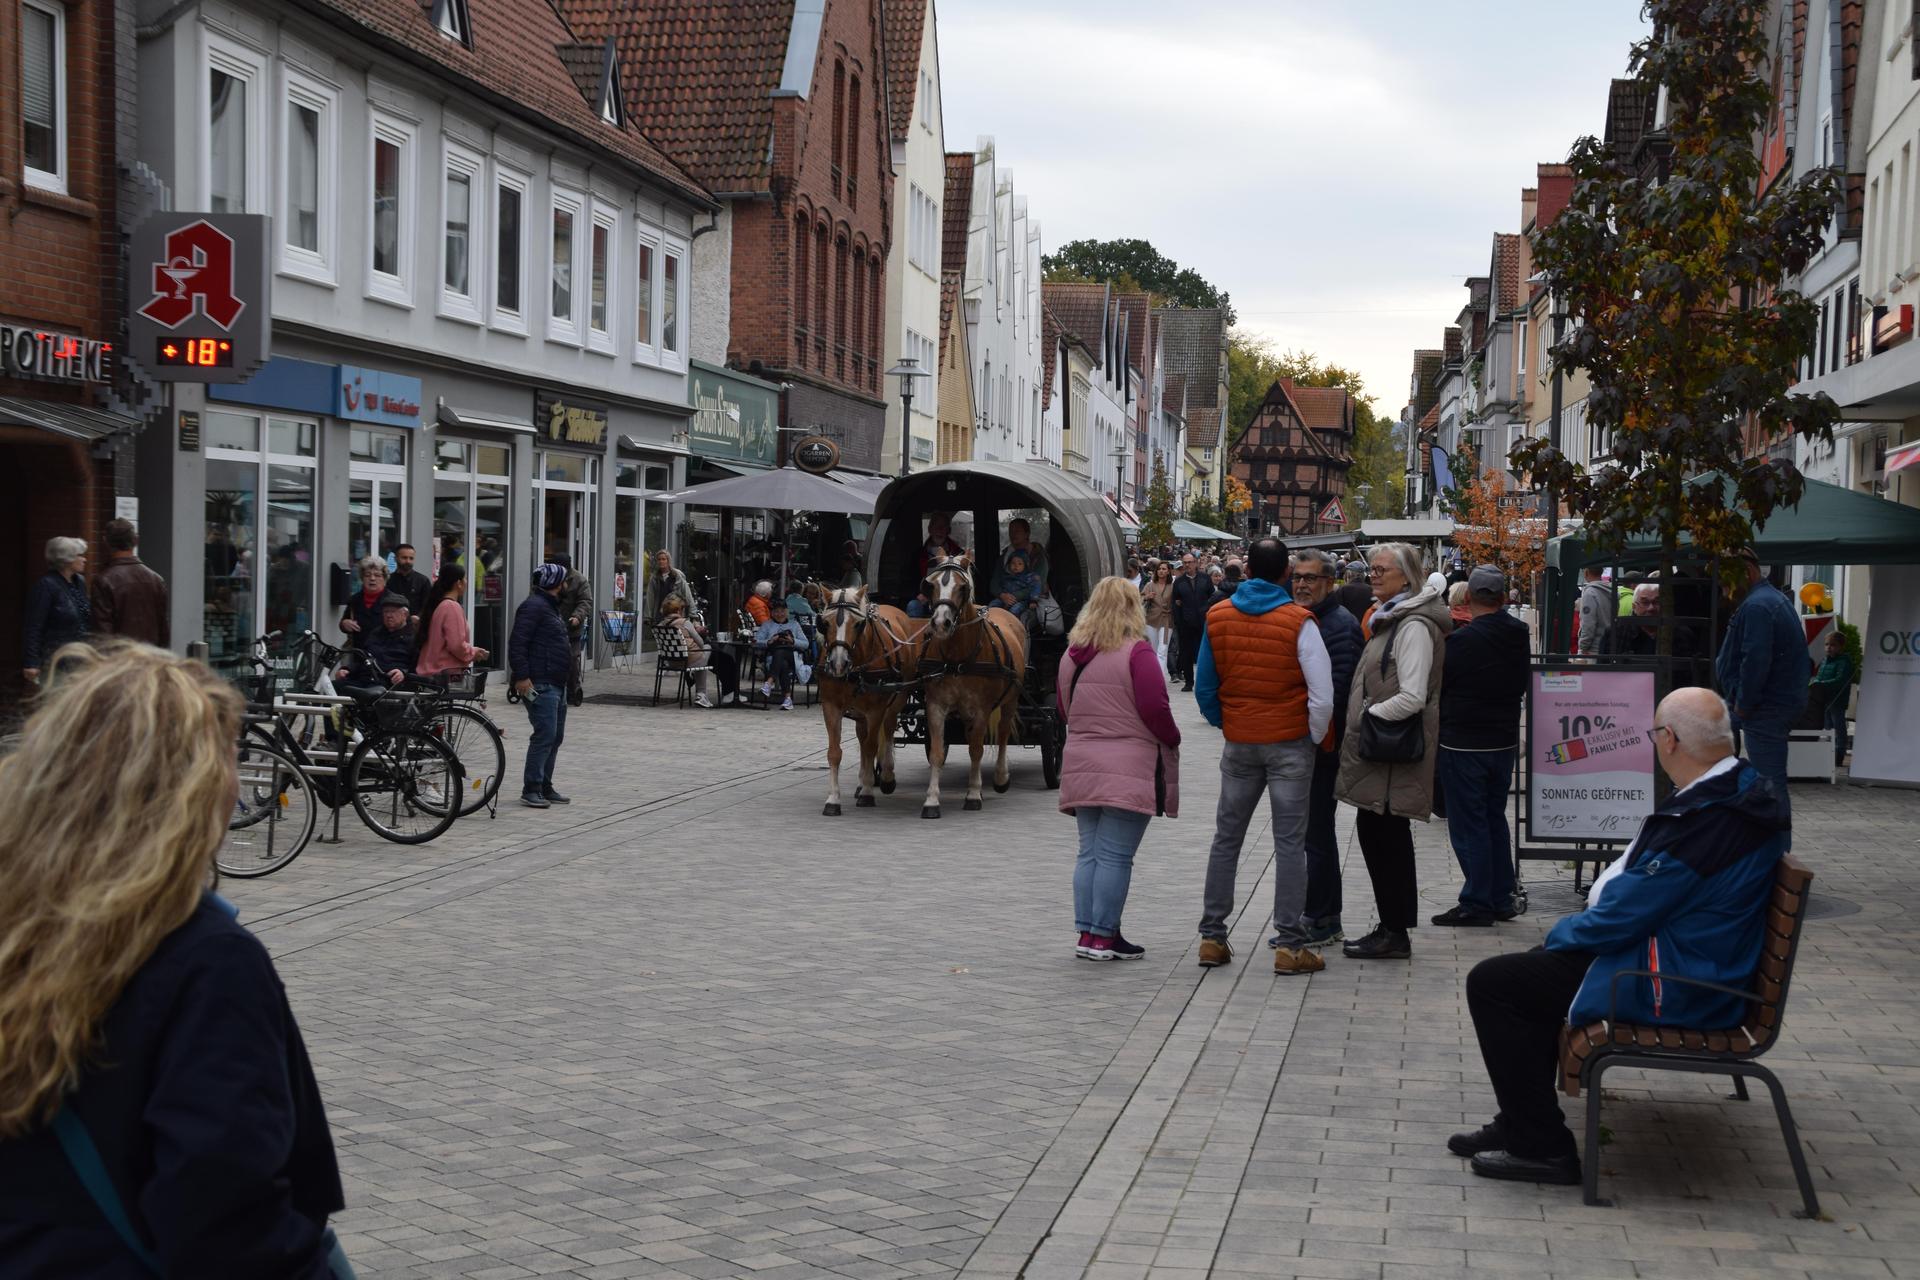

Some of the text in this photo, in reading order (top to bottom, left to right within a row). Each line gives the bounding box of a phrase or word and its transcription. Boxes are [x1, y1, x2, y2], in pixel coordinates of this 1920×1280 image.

[1587, 726, 1635, 745] EXKLUSIV MIT
[1590, 736, 1640, 755] FAMILY CARD
[1542, 787, 1645, 800] SONNTAG GEÖFFNET:
